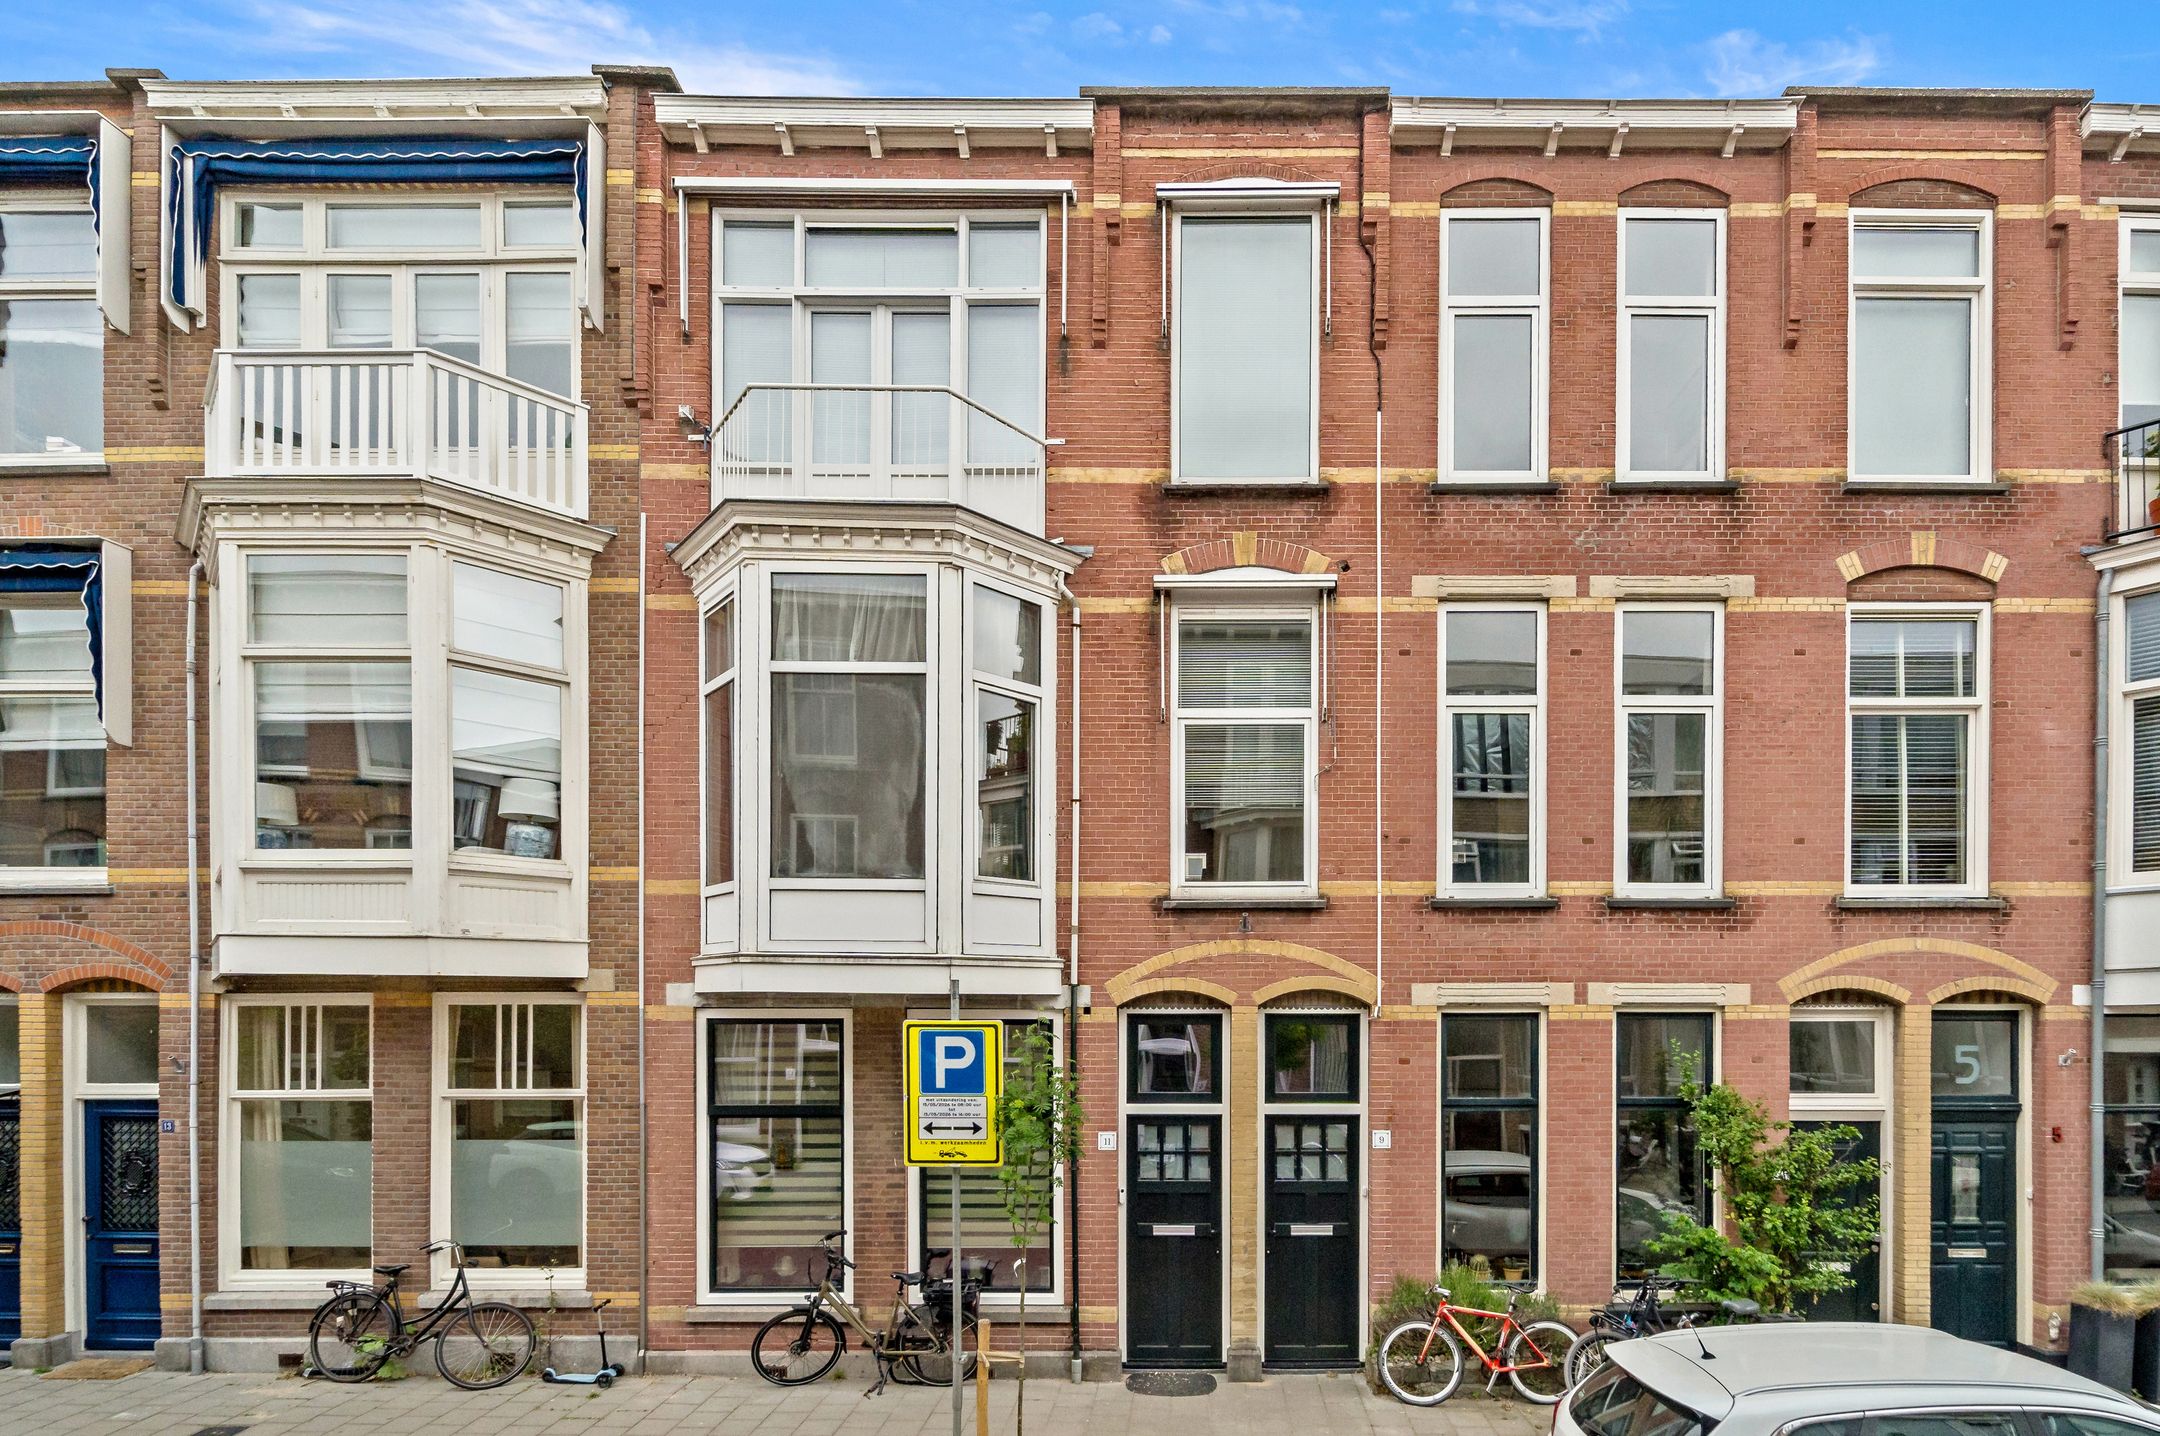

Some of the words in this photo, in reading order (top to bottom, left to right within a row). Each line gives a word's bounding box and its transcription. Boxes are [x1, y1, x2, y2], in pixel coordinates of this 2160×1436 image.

[935, 1036, 976, 1089] P
[1955, 1045, 1980, 1085] 5
[2051, 1126, 2064, 1144] 5
